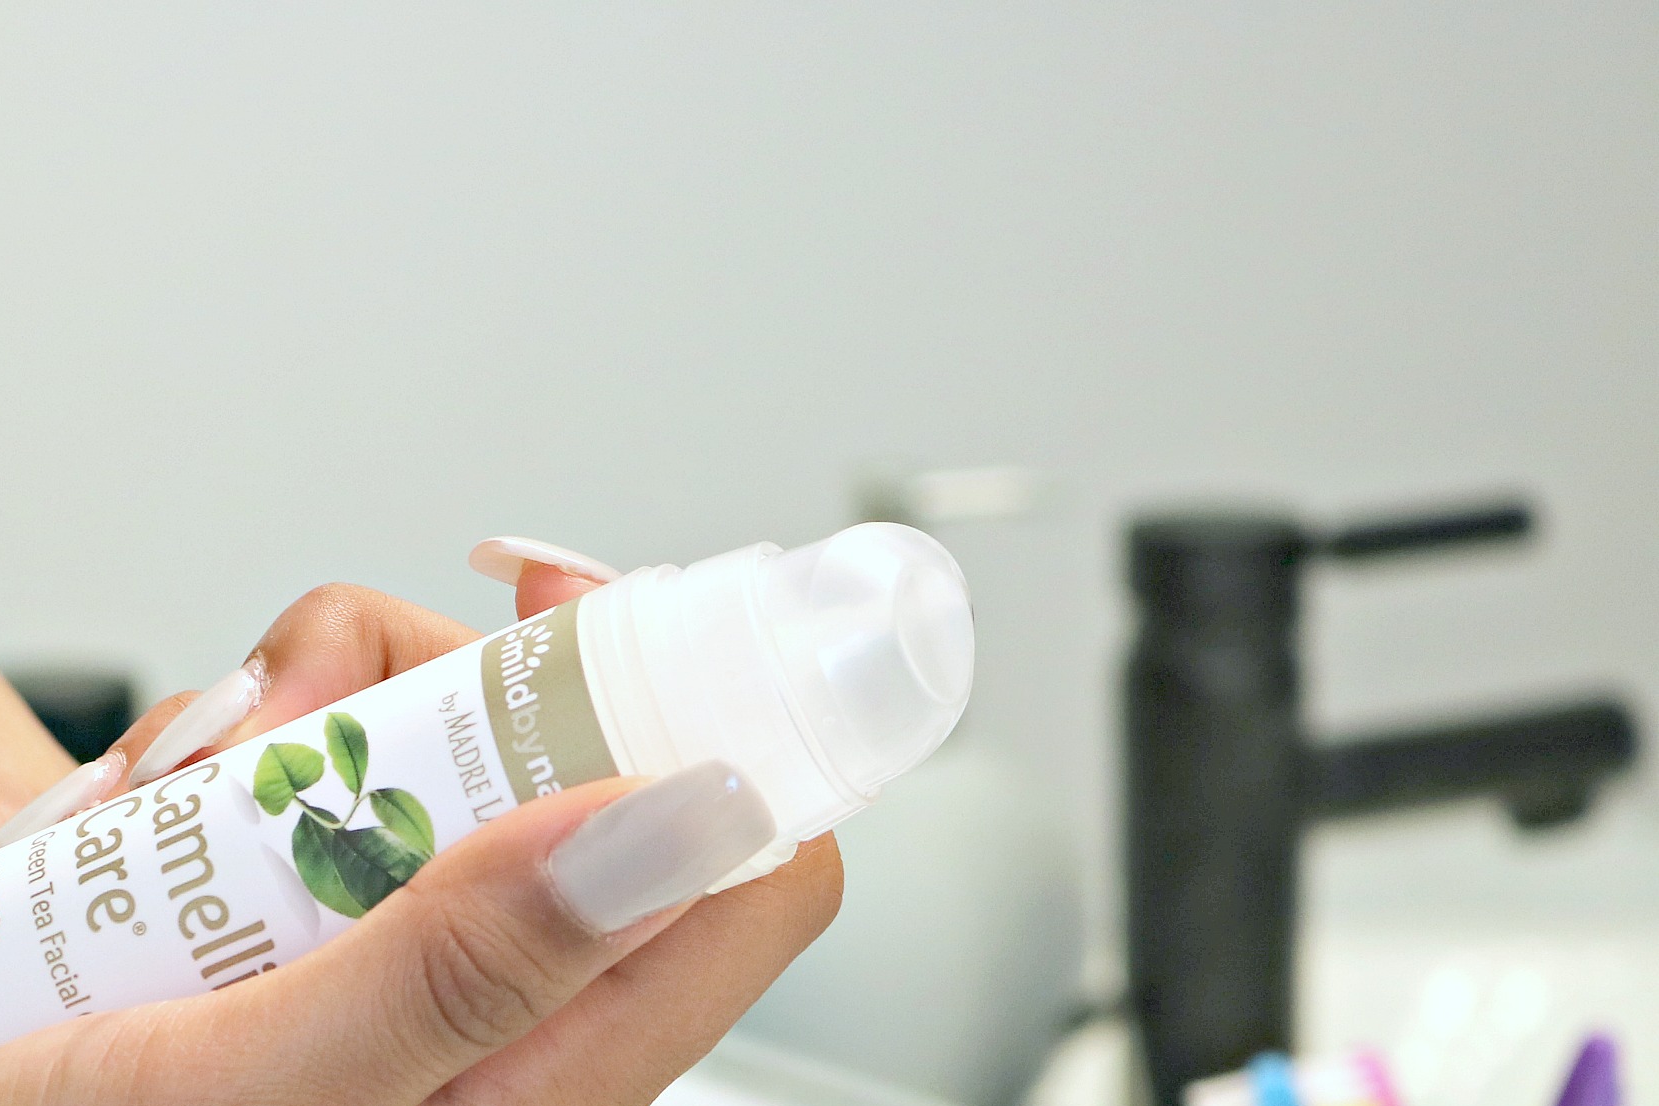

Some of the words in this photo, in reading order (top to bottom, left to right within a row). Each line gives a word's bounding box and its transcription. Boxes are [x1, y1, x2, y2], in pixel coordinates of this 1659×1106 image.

[439, 691, 458, 714] by
[444, 711, 492, 799] MADRE
[472, 797, 503, 823] L
[28, 831, 56, 884] Green
[30, 881, 55, 930] Tea
[40, 930, 91, 1009] Facial
